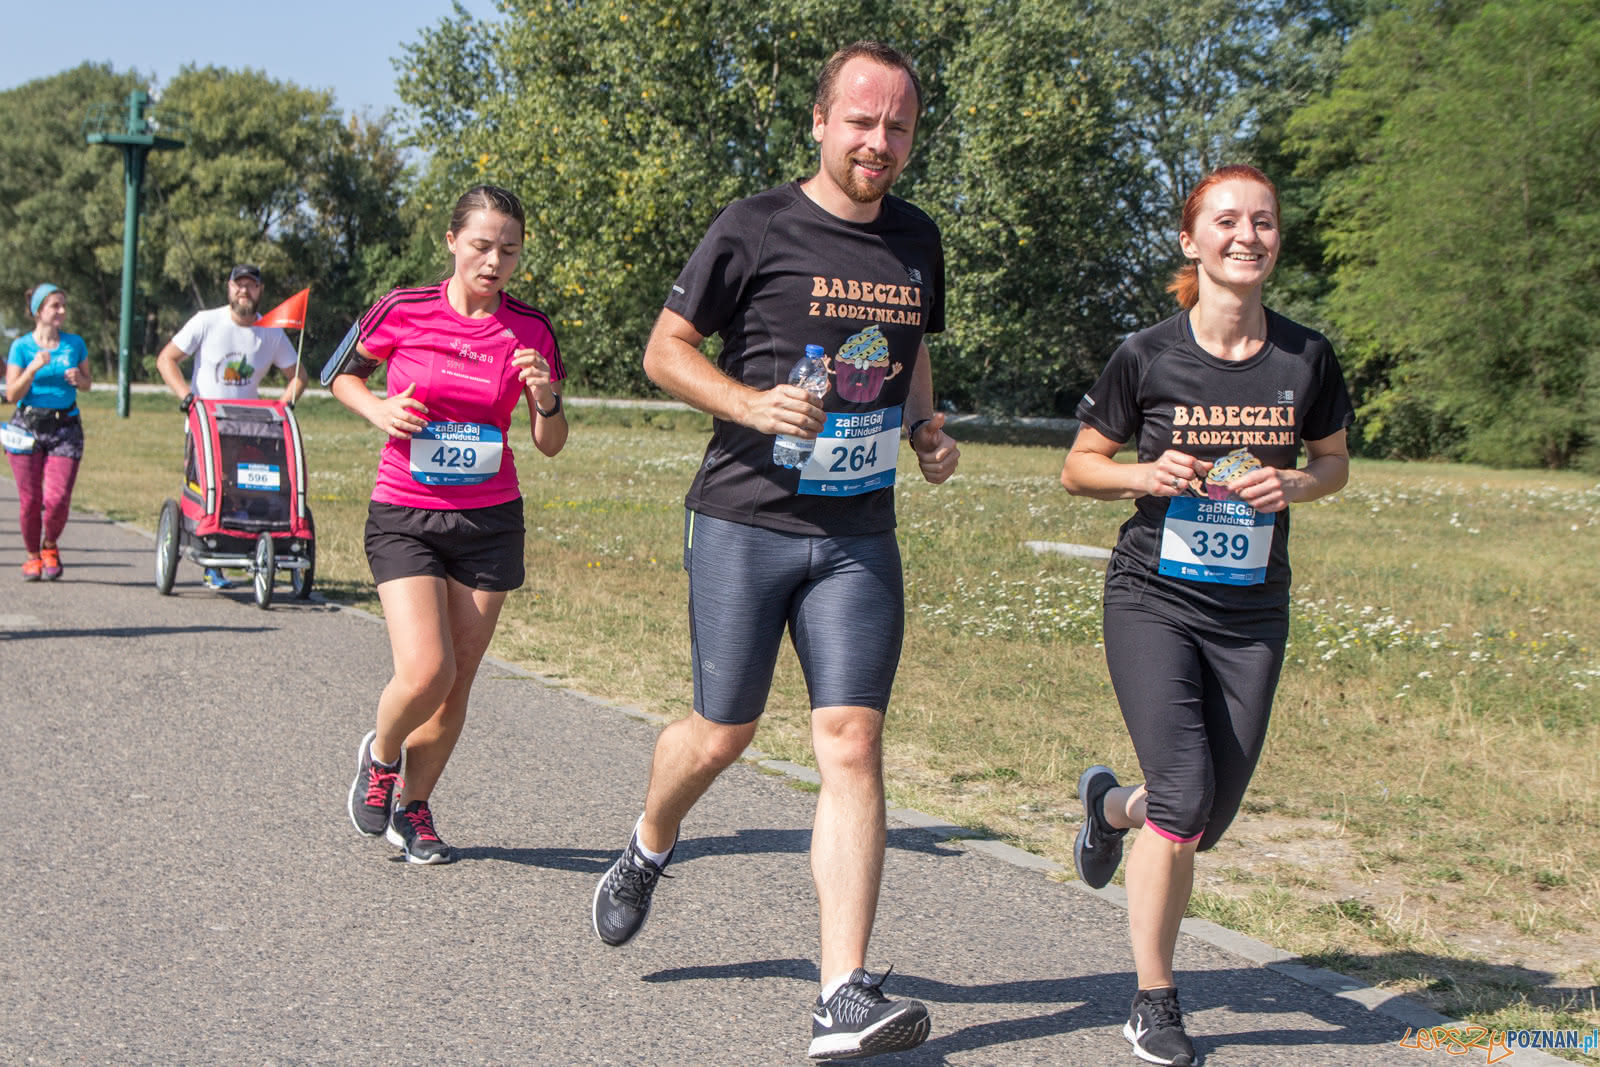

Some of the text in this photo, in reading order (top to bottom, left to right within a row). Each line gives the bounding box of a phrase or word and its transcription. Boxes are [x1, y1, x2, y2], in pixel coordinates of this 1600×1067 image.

[811, 276, 921, 307] BABECZKI
[808, 302, 921, 326] Z RODZYNKAMI
[834, 411, 884, 428] zaBIEGaj
[1172, 405, 1296, 426] BABECZKI
[435, 424, 480, 434] zaBIEGaj
[441, 433, 480, 441] FUNdusze
[844, 425, 882, 438] FUNdusze
[1172, 430, 1295, 445] Z RODZYNKAMI
[431, 446, 476, 468] 429
[829, 441, 877, 472] 264
[248, 472, 268, 482] 596
[1198, 502, 1257, 518] zaBIEGaj
[1206, 514, 1255, 526] FUNdusze
[1191, 530, 1249, 560] 339
